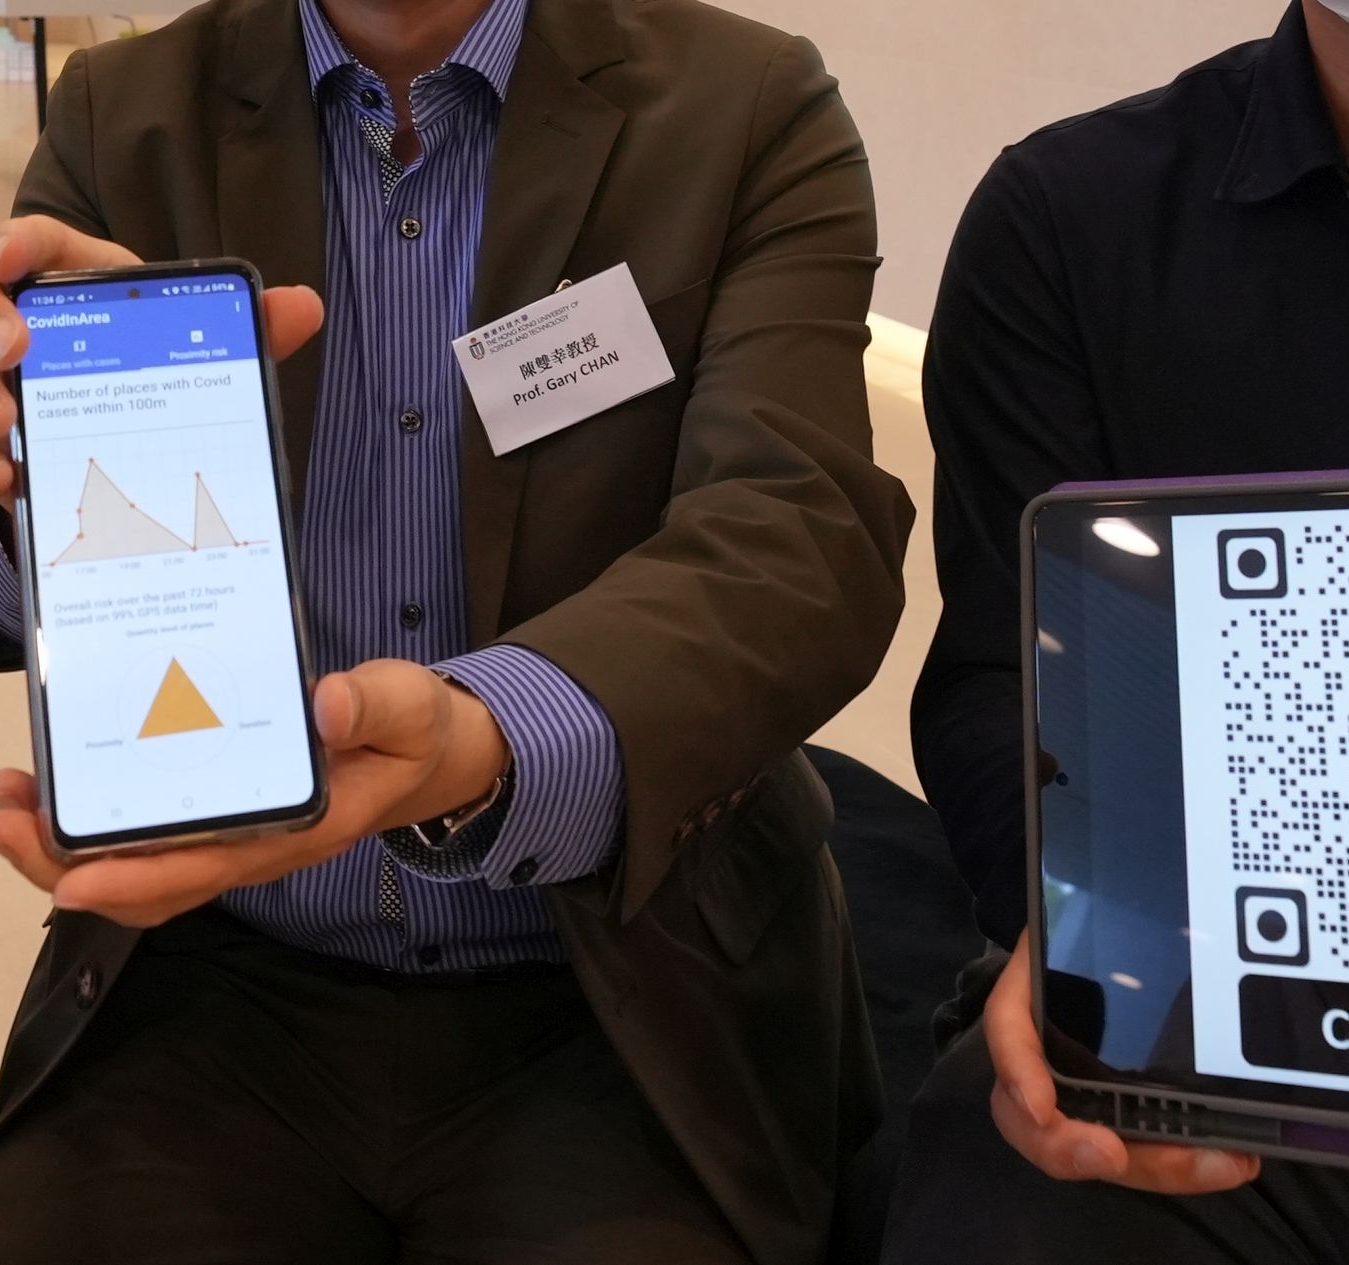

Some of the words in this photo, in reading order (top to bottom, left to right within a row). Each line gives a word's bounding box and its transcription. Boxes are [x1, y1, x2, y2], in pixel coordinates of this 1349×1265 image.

[27, 312, 111, 329] CovidInArea
[498, 328, 518, 342] HONG
[518, 319, 538, 333] KONG
[537, 305, 570, 324] UNIVERSITY
[570, 300, 579, 310] OF
[514, 335, 529, 346] AND
[528, 314, 569, 339] TECHNOLOGY
[169, 349, 211, 360] Proximity
[519, 333, 600, 381] 陳雙幸教授
[36, 387, 91, 402] Number
[95, 384, 110, 397] of
[113, 381, 158, 397] places
[161, 377, 190, 391] with
[194, 374, 232, 389] Covid
[513, 385, 545, 406] Prof.
[546, 370, 578, 392] Gary
[579, 350, 620, 377] CHAN
[37, 406, 79, 420] cases
[82, 400, 124, 416] within
[128, 397, 167, 412] 100m
[54, 602, 91, 614] Overall
[94, 598, 113, 609] risk
[117, 597, 140, 607] over
[143, 592, 160, 603] the
[163, 590, 186, 603] past
[205, 585, 235, 597] hours
